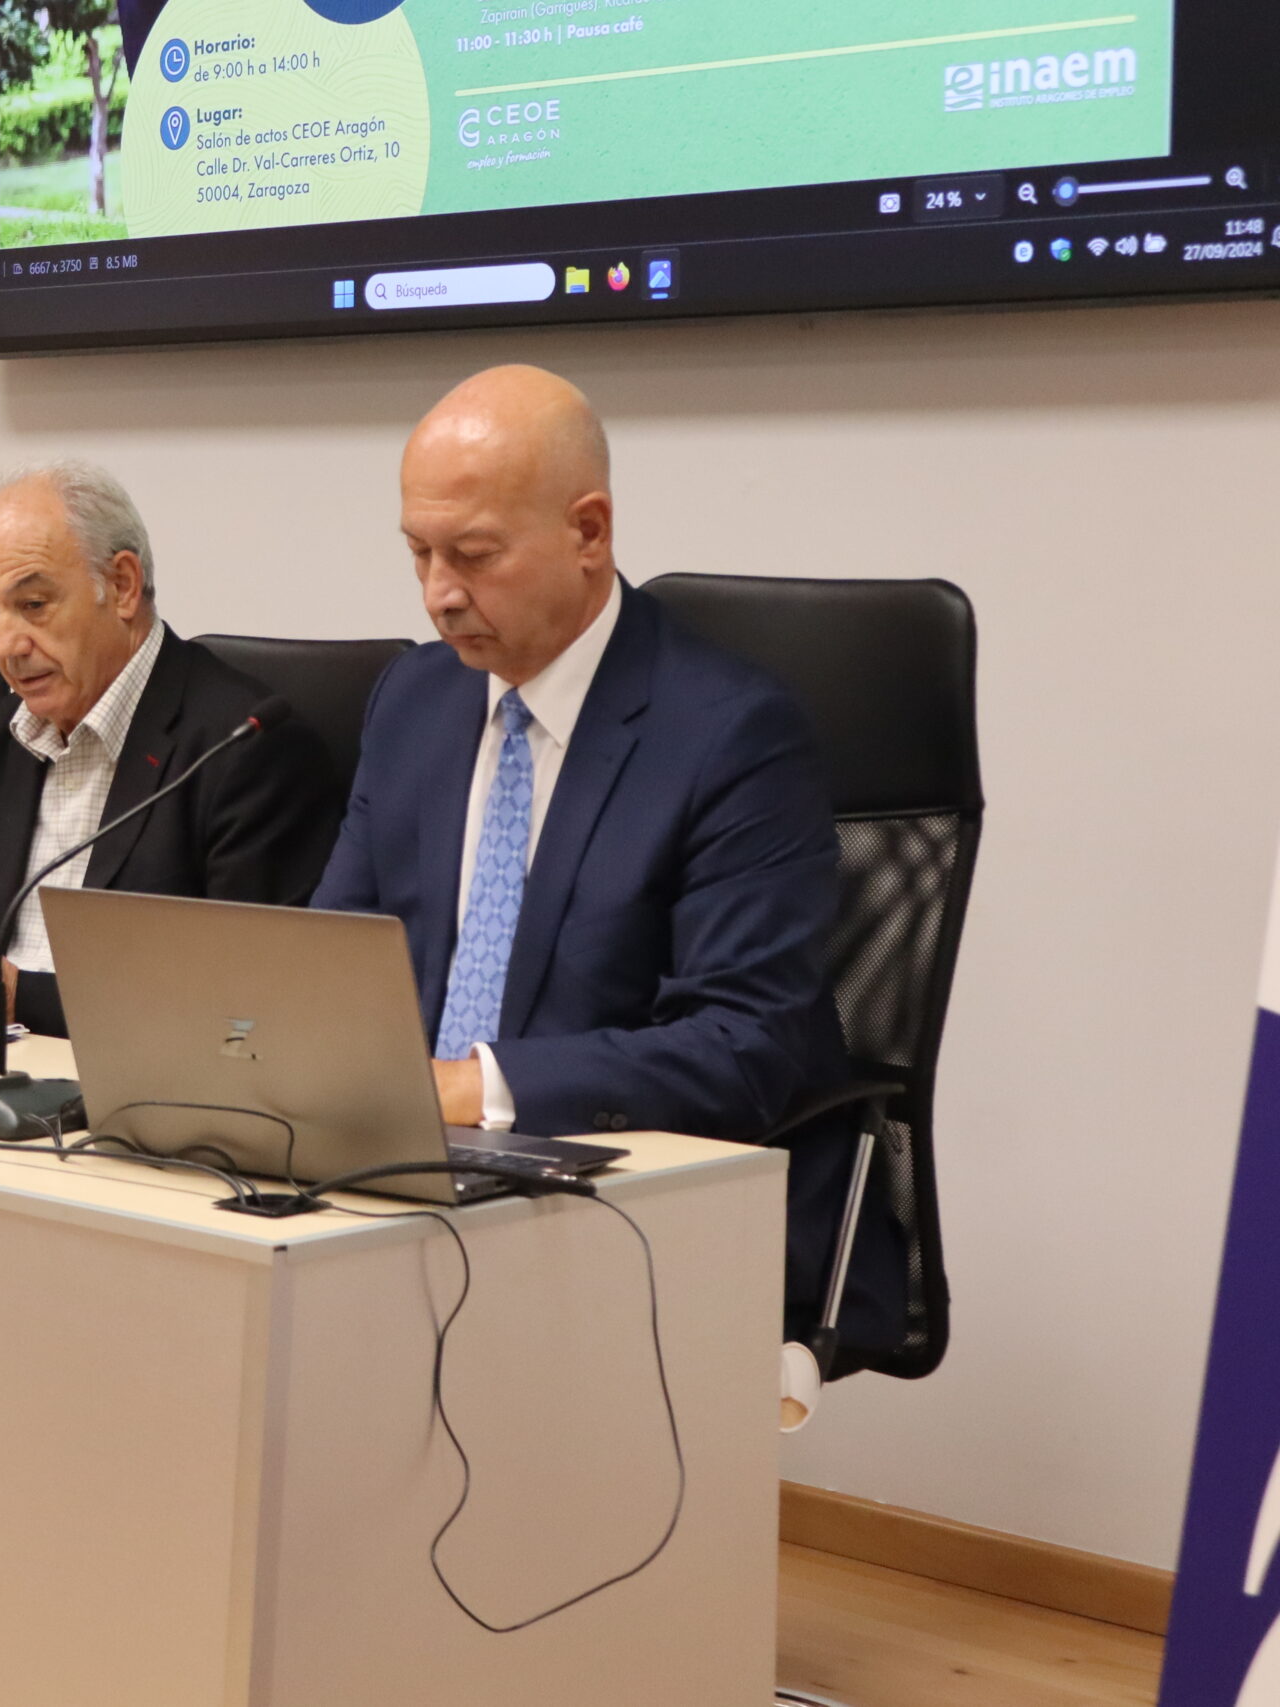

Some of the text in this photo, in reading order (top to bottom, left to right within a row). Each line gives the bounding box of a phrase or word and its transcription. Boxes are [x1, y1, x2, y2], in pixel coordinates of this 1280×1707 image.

[480, 7, 527, 25] Zapirain
[457, 34, 492, 52] 11:00
[505, 29, 541, 47] 11:30
[544, 26, 553, 42] h
[567, 22, 610, 39] Pausa
[613, 16, 644, 33] café
[194, 33, 255, 56] Horario:
[194, 50, 320, 82] de 9:00 h a 14:00 h
[989, 47, 1137, 95] inaem
[196, 107, 243, 127] Lugar:
[487, 99, 560, 126] CEOE
[196, 116, 385, 150] Salón de actos CEOE Aragón
[487, 128, 560, 145] ARAGÓN
[196, 141, 400, 176] Calle Dr. Val-Carreres Ortiz, 10
[467, 147, 551, 170] empleo y formación
[196, 182, 310, 203] 50004, Zaragoza
[926, 190, 962, 210] 24 %
[1225, 218, 1264, 236] 11:48
[1183, 241, 1263, 261] 27/09/2024
[29, 259, 82, 275] 6667 x 3750
[106, 254, 138, 270] 8.5 MB
[396, 283, 447, 300] Búsqueda
